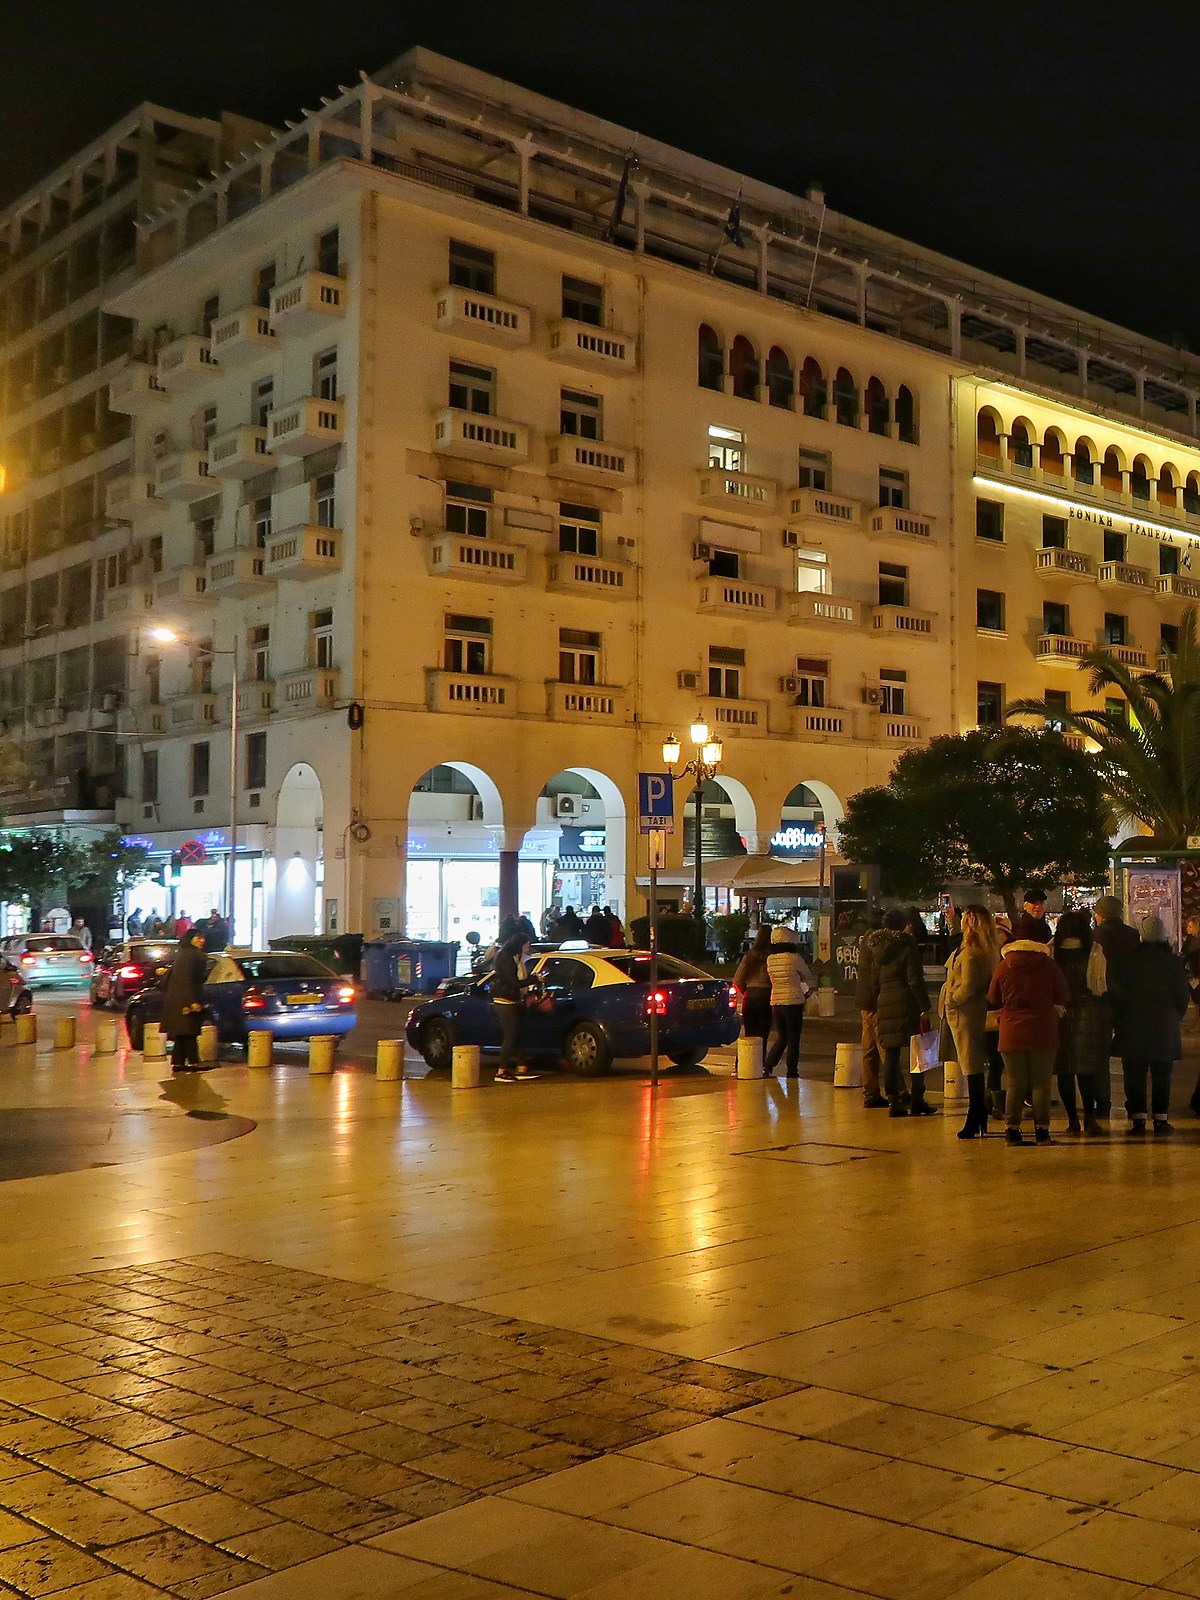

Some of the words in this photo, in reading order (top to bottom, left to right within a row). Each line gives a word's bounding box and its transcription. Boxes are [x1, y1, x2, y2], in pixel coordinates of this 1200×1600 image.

[1069, 507, 1112, 527] ΕΘΝΙΚΗ
[1129, 523, 1173, 542] ΤΡΑΠΕΖΑ
[647, 776, 666, 813] P
